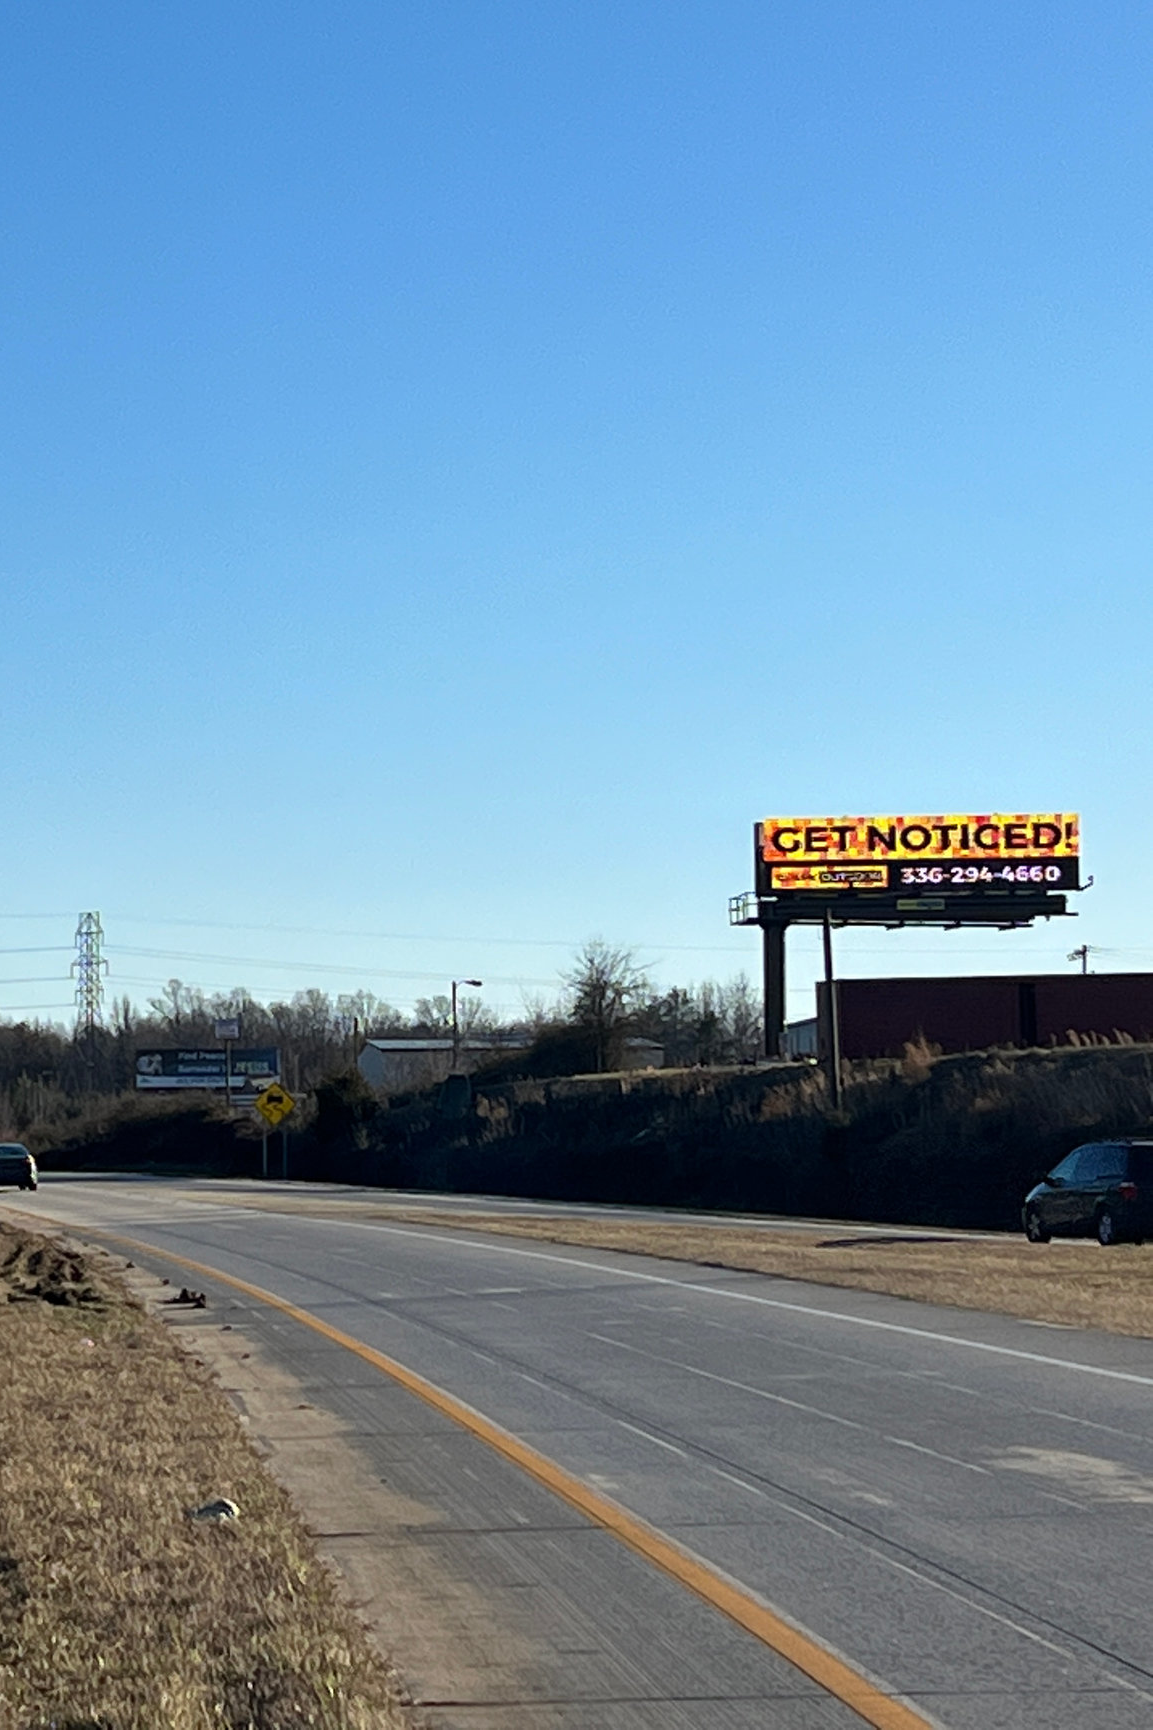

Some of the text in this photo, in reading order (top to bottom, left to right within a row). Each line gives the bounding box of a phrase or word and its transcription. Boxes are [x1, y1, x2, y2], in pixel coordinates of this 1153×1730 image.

[772, 822, 1073, 853] GET NOTICED!
[900, 865, 1061, 884] 336-294-4660
